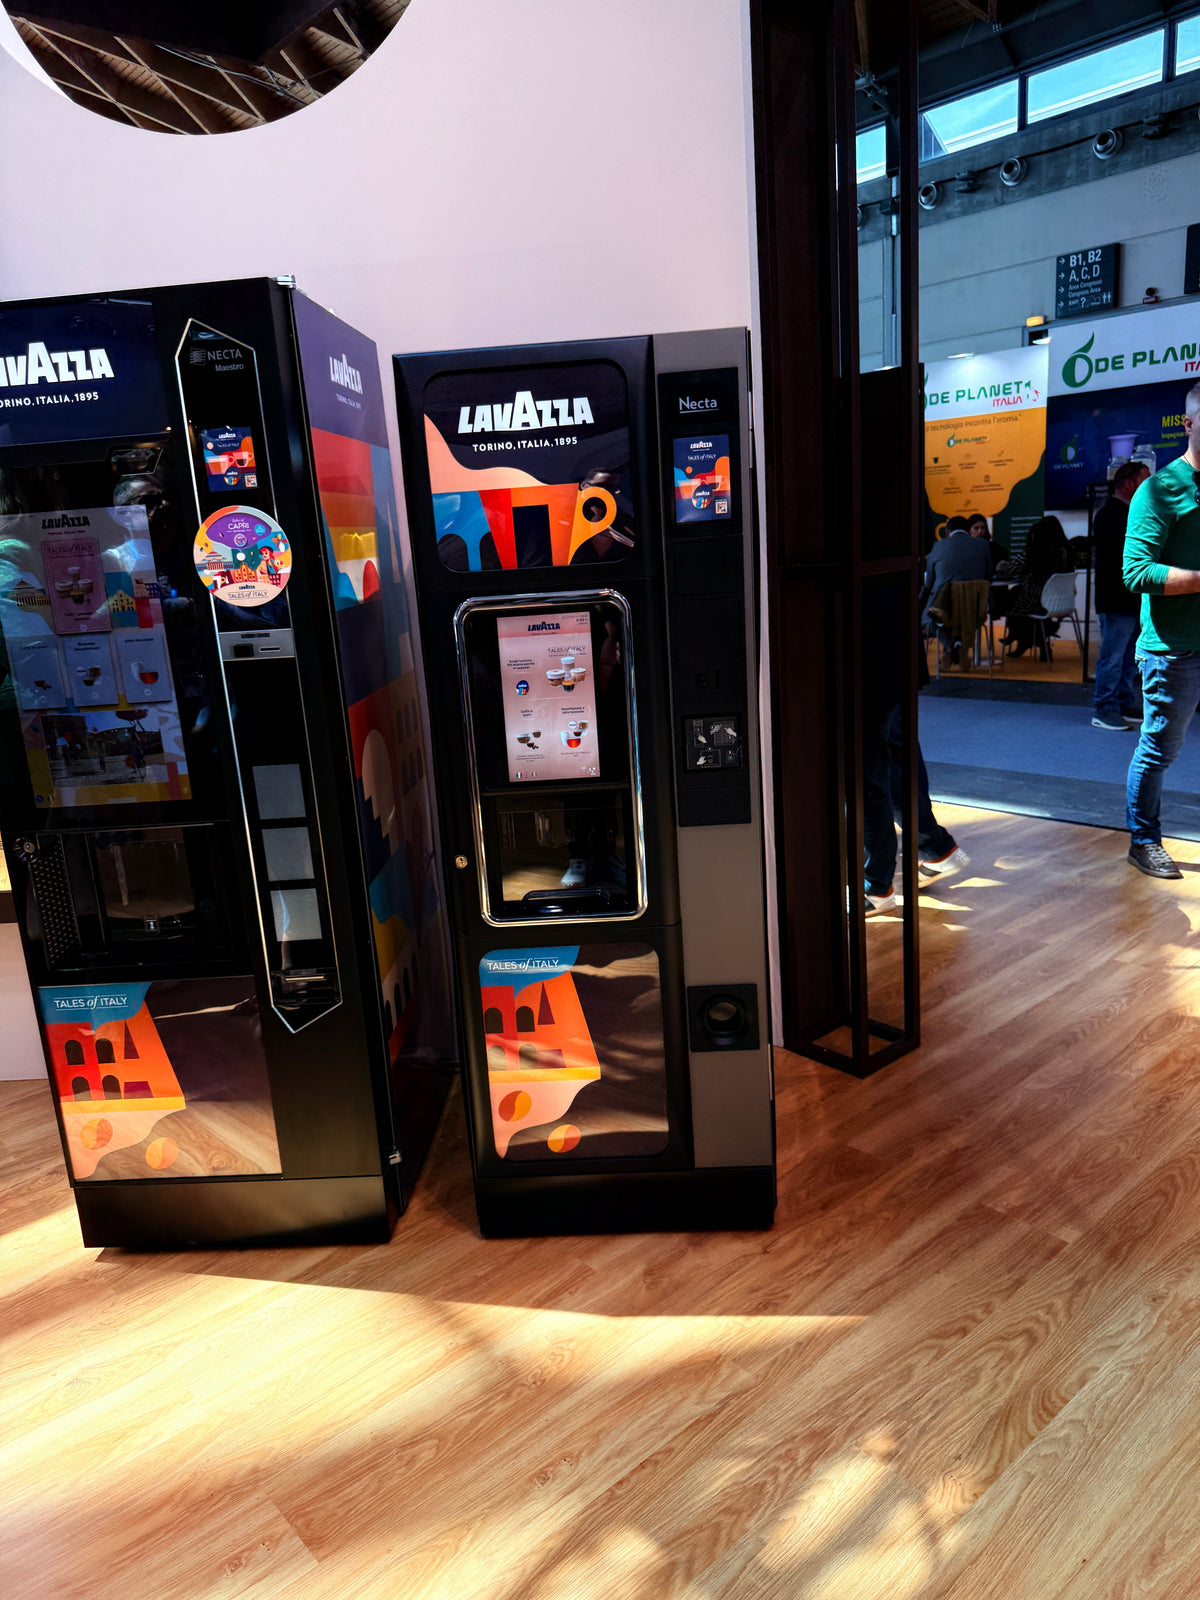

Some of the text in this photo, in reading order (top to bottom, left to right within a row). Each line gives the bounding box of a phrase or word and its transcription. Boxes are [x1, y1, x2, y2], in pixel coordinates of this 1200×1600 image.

[1069, 248, 1102, 268] B1, B2
[1069, 264, 1100, 282] A, C, D
[207, 349, 243, 361] NECTA
[1131, 342, 1200, 368] PLAN
[215, 363, 245, 372] Maestro
[329, 353, 363, 395] LAVAZZA
[74, 391, 99, 402] 1895
[955, 380, 1023, 402] PLANET
[678, 395, 718, 411] Necta
[992, 396, 1023, 408] ITALIA
[457, 391, 595, 434] LAVAZZA
[931, 422, 963, 431] tecnologia
[964, 418, 991, 427] incontra
[1161, 414, 1186, 428] MISS
[554, 436, 578, 446] 1895
[690, 441, 713, 449] LAVAZZA
[42, 514, 91, 529] LAVAZZA
[228, 522, 250, 530] CAPRI
[527, 621, 561, 632] LAVAZZA
[487, 957, 559, 972] TALES of ITALY
[53, 995, 128, 1010] TALES of ITALY
